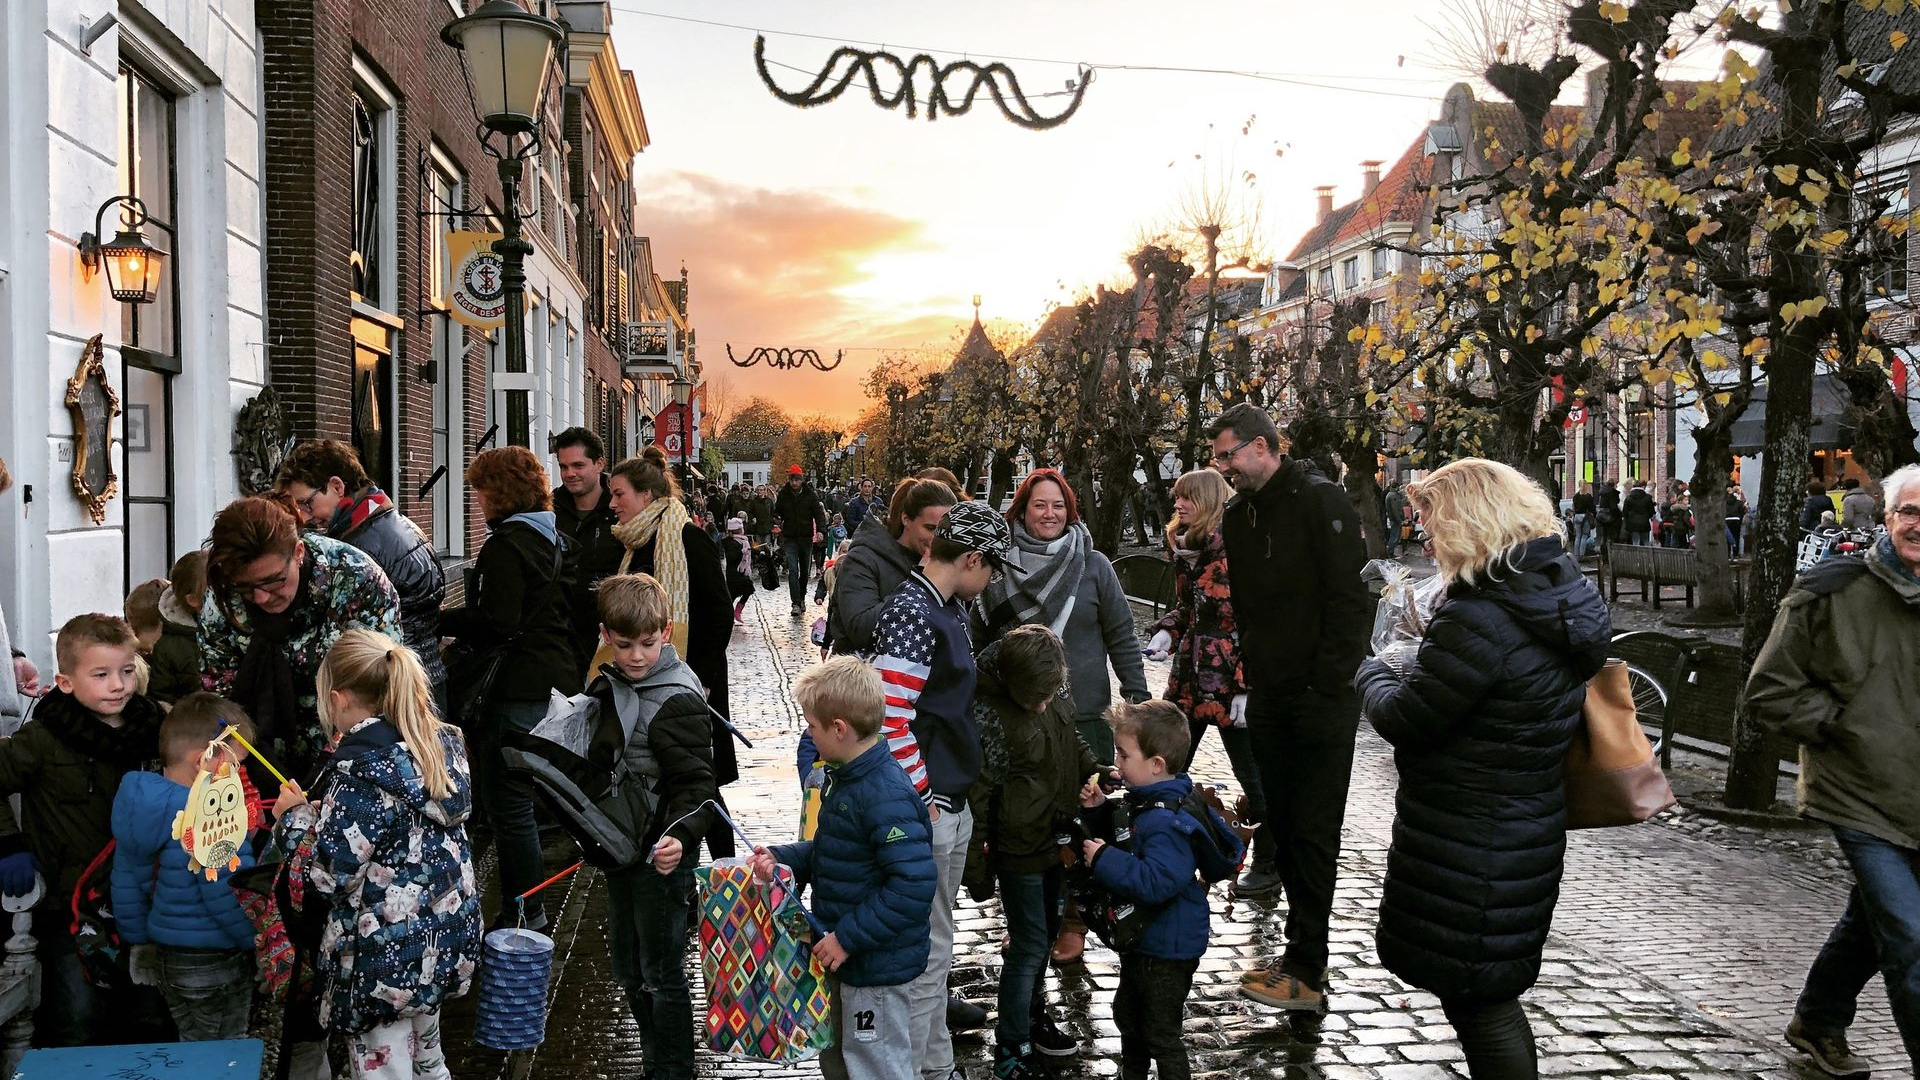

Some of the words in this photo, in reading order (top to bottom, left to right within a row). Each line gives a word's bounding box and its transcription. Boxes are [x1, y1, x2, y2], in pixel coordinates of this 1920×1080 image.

[483, 257, 494, 265] EN
[456, 294, 477, 314] LEGER
[480, 308, 496, 317] DES
[854, 1010, 875, 1030] 12
